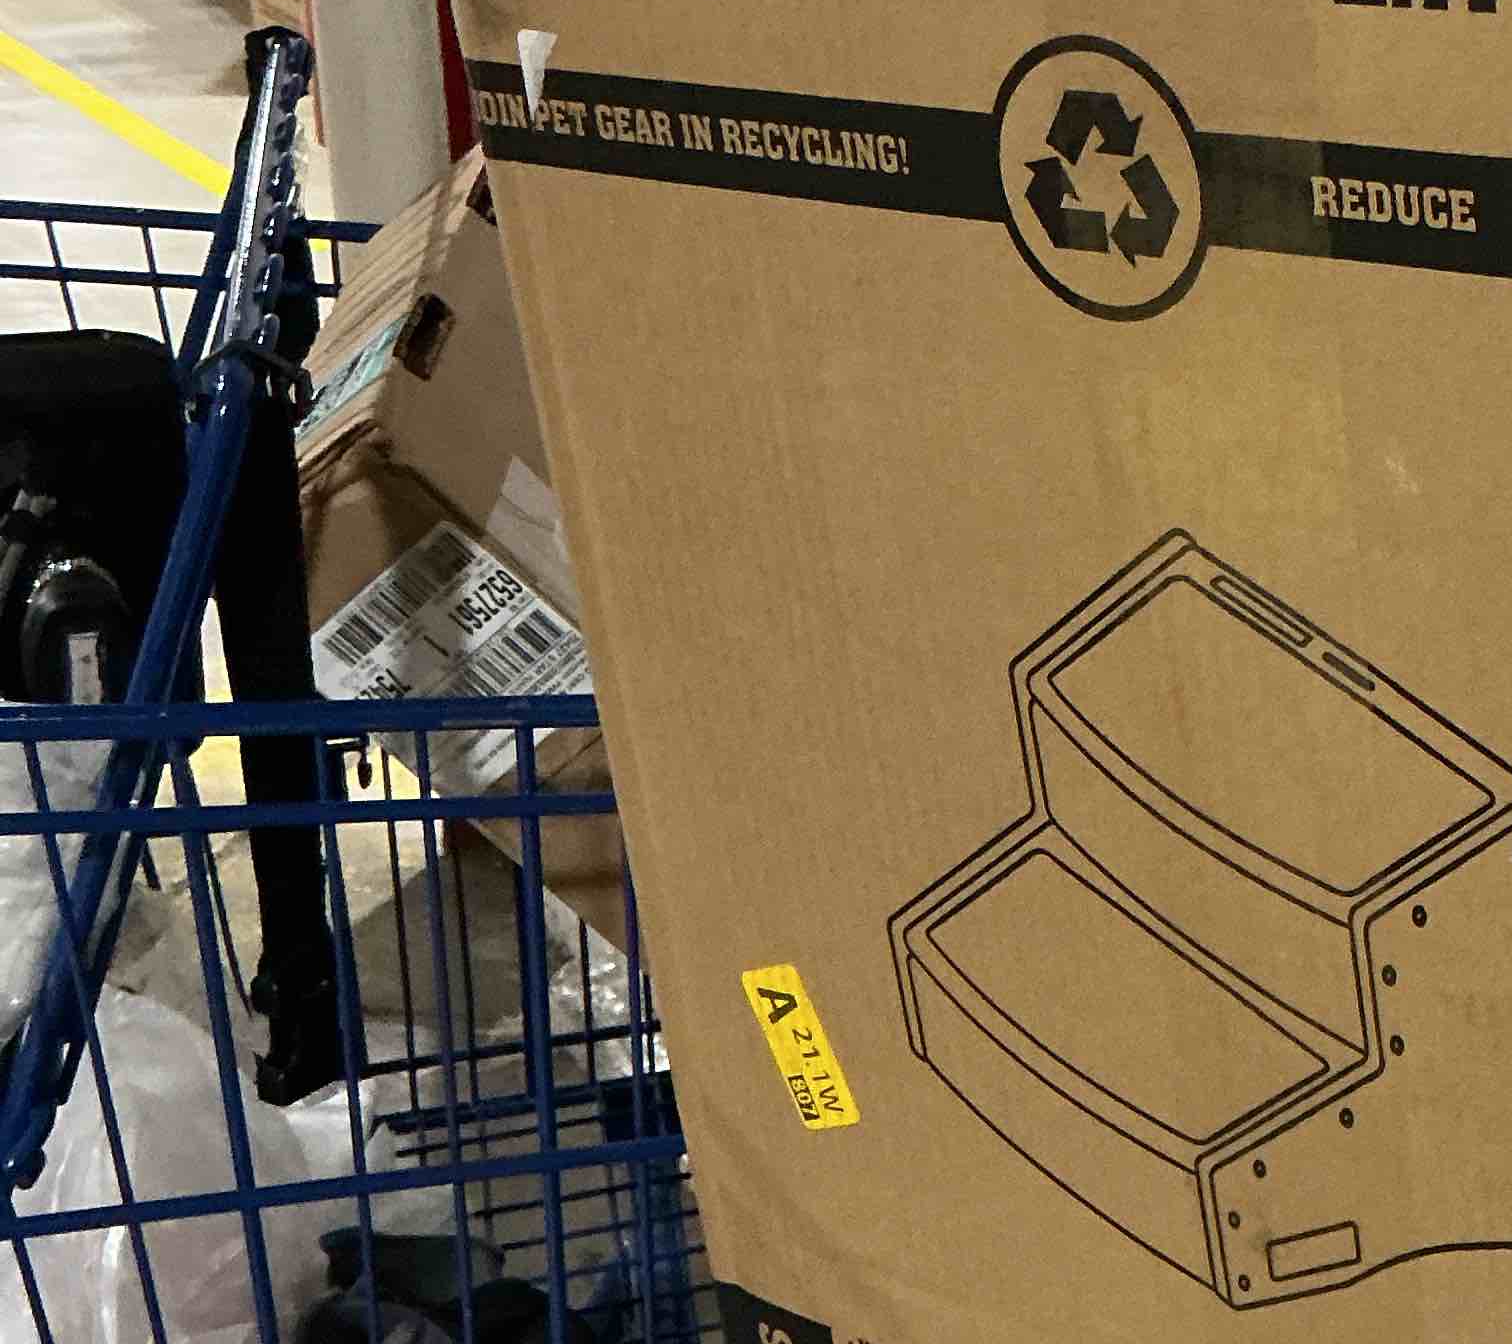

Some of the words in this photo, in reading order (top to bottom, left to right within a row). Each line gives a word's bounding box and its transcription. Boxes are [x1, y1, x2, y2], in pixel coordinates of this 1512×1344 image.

[533, 97, 587, 137] PET
[594, 104, 675, 148] GEAR
[679, 112, 714, 152] IN
[723, 117, 909, 176] RECYCLING!
[1311, 175, 1477, 234] REDUCE
[756, 987, 799, 1024] A
